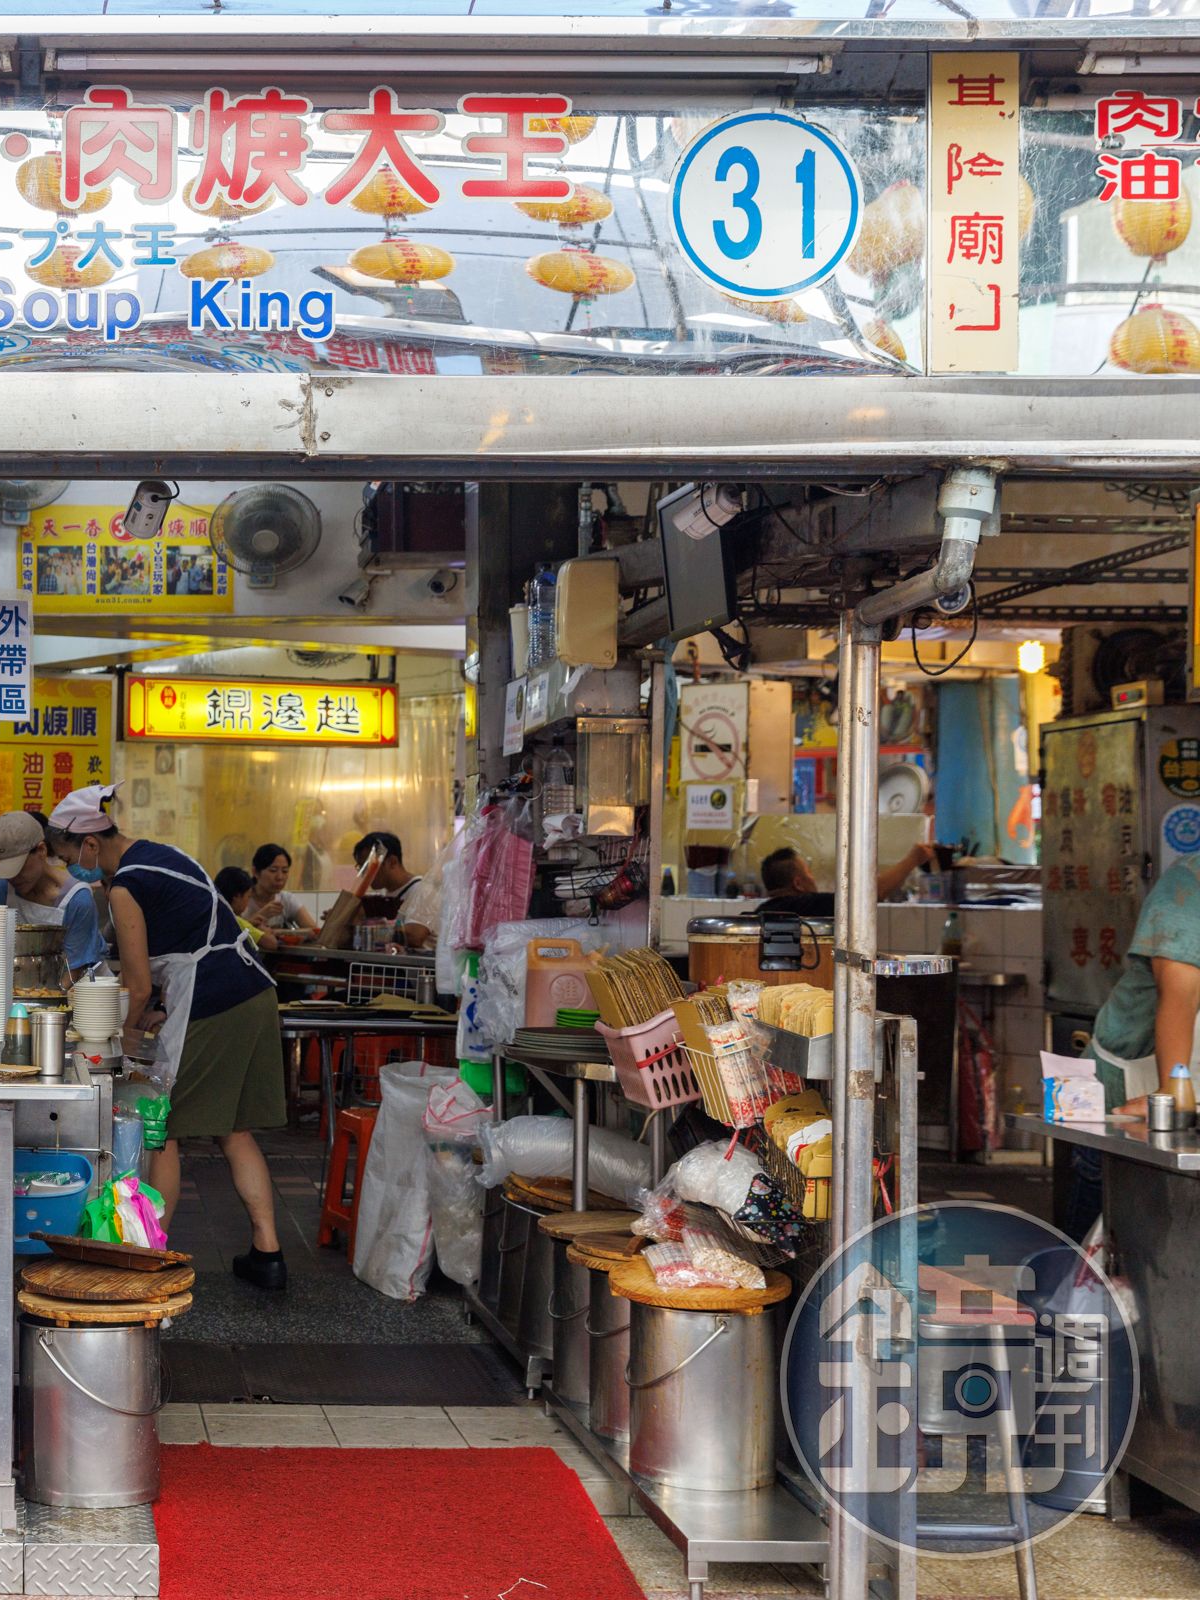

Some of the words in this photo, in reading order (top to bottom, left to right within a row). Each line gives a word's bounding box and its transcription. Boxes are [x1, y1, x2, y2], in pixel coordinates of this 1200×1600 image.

[1097, 89, 1200, 139] 肉
[1098, 153, 1200, 201] 油
[712, 145, 818, 260] 31
[189, 279, 335, 340] King
[42, 517, 103, 539] 天一香
